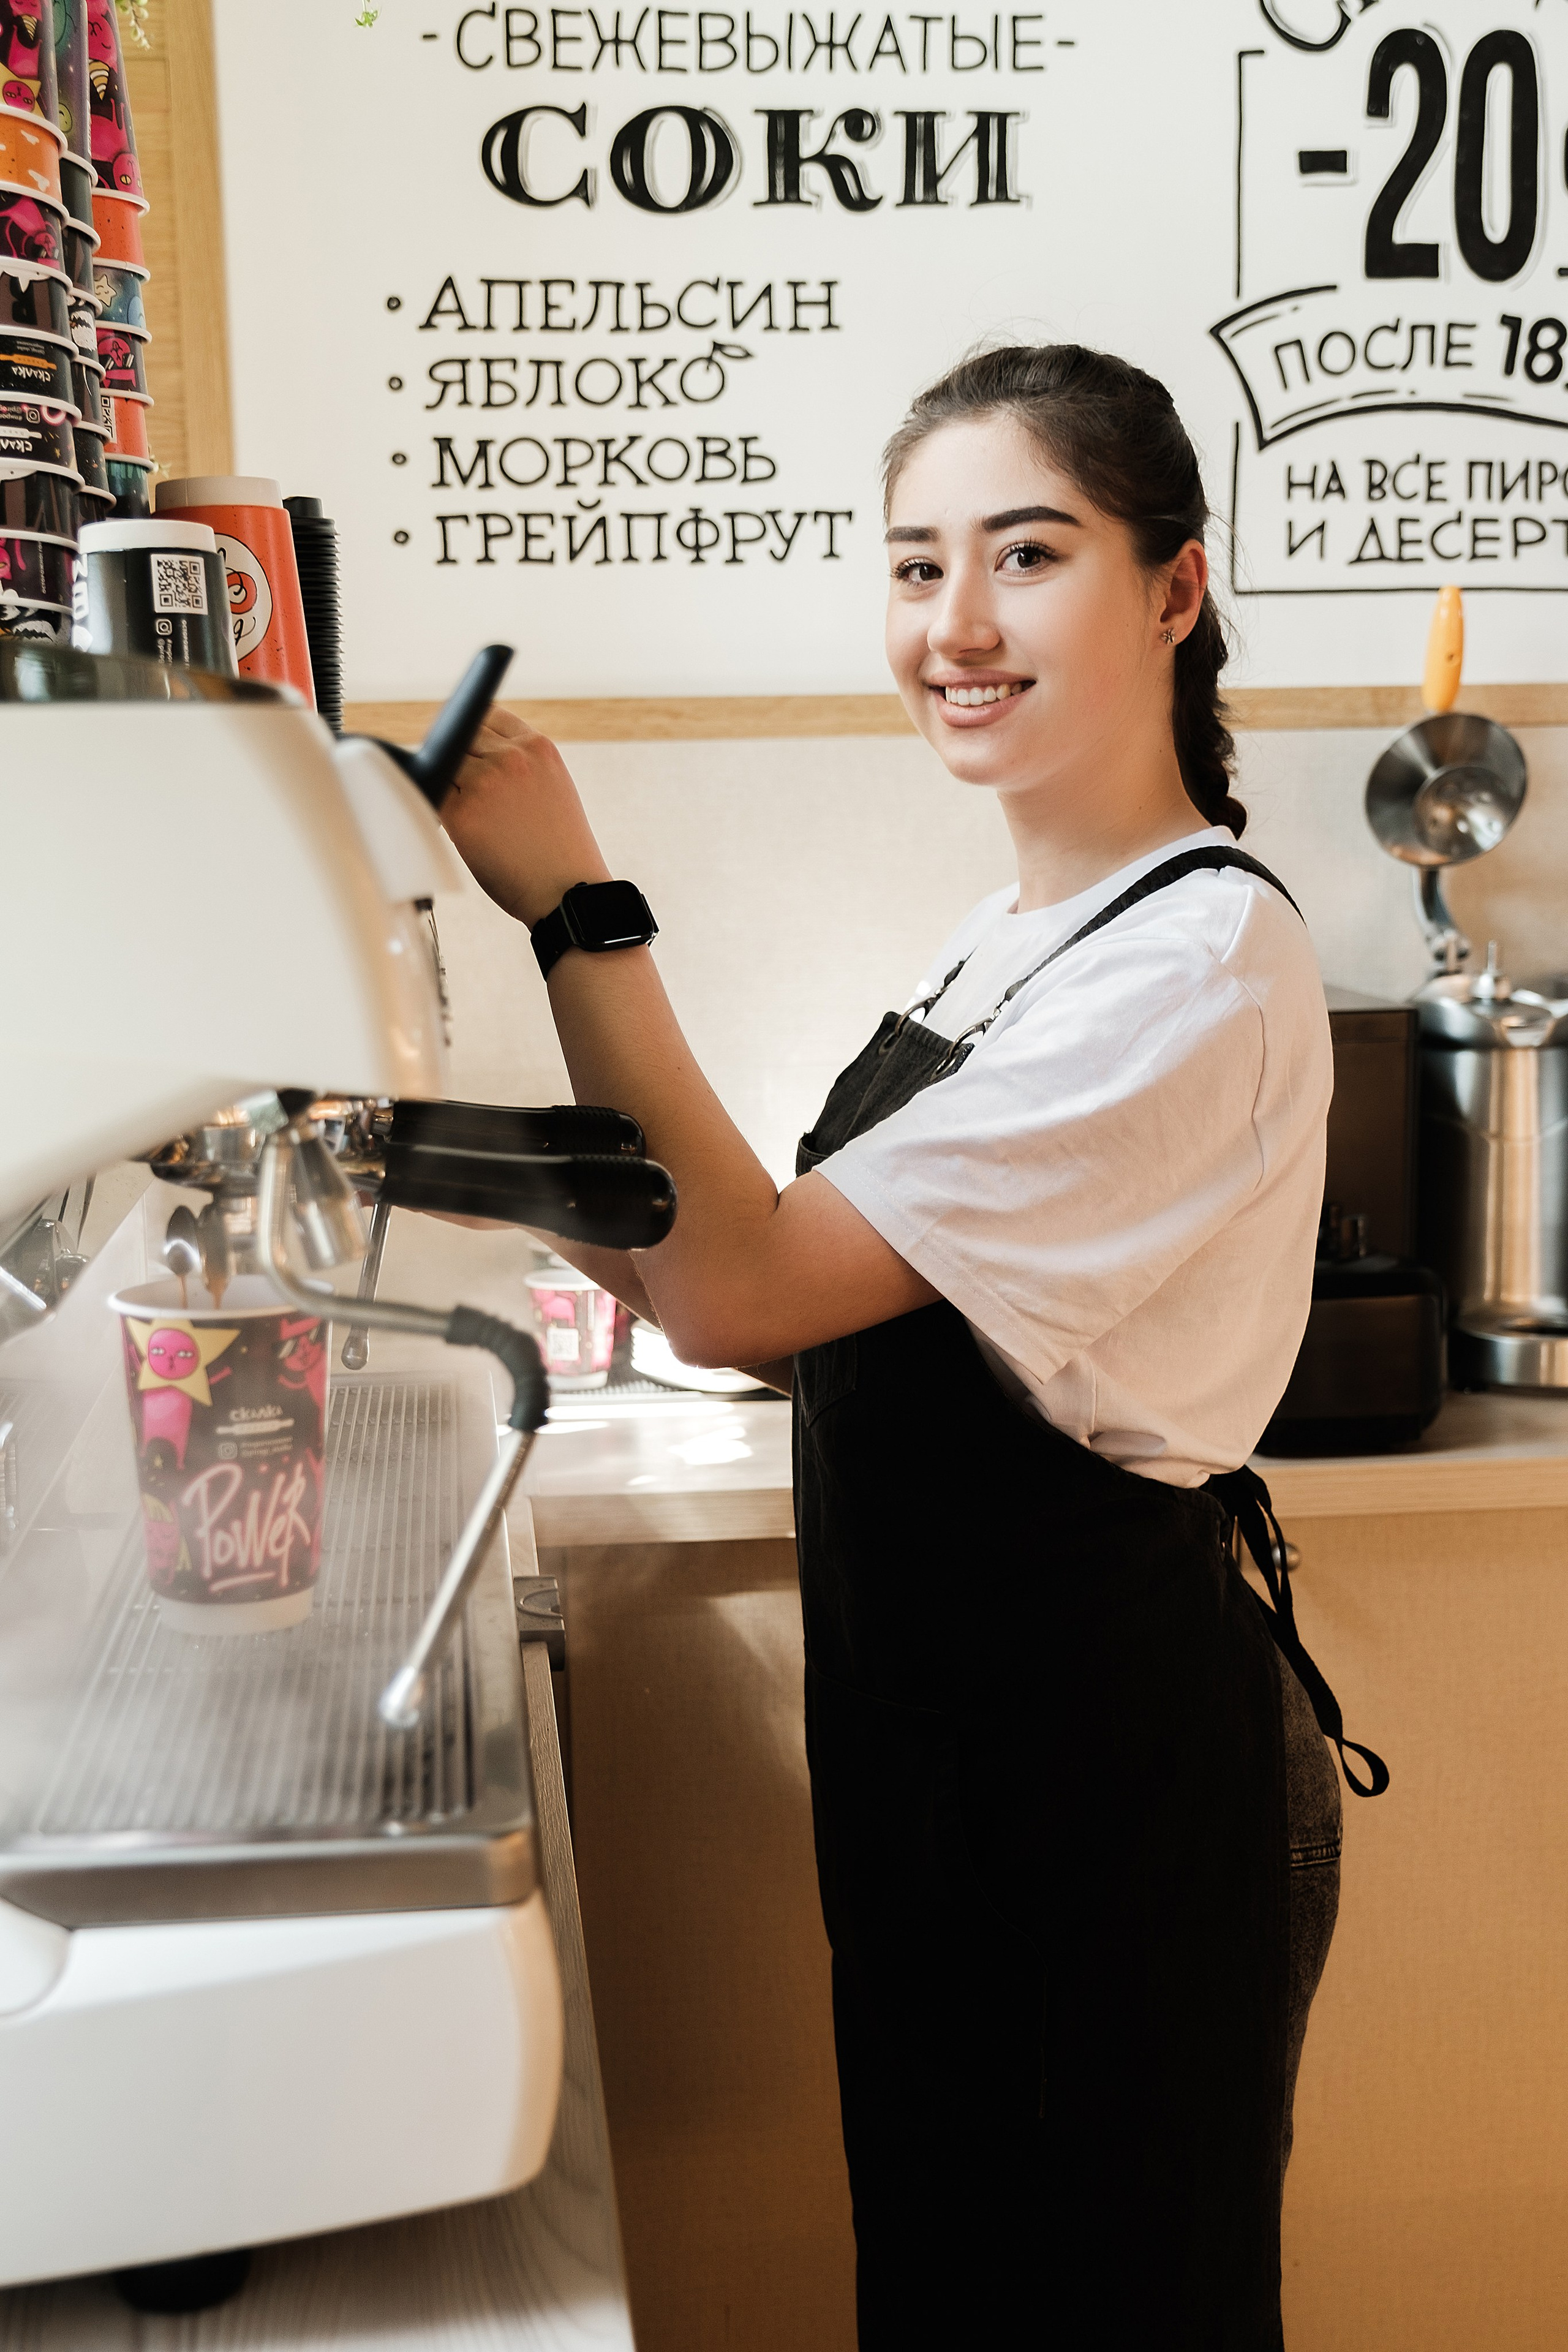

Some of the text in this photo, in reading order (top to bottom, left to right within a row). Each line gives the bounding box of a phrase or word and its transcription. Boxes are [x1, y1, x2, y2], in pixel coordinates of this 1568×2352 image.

[481, 102, 1030, 214] СОКИ
[419, 276, 840, 333] АПЕЛЬСИН
[424, 341, 752, 410] ЯБЛОКО
[1273, 317, 1477, 390] ПОСЛЕ
[431, 435, 777, 489] МОРКОВЬ
[1287, 453, 1568, 502] НА ВСЕ ПИР
[435, 499, 853, 565] ГРЕЙПФРУТ
[1288, 520, 1326, 559] И
